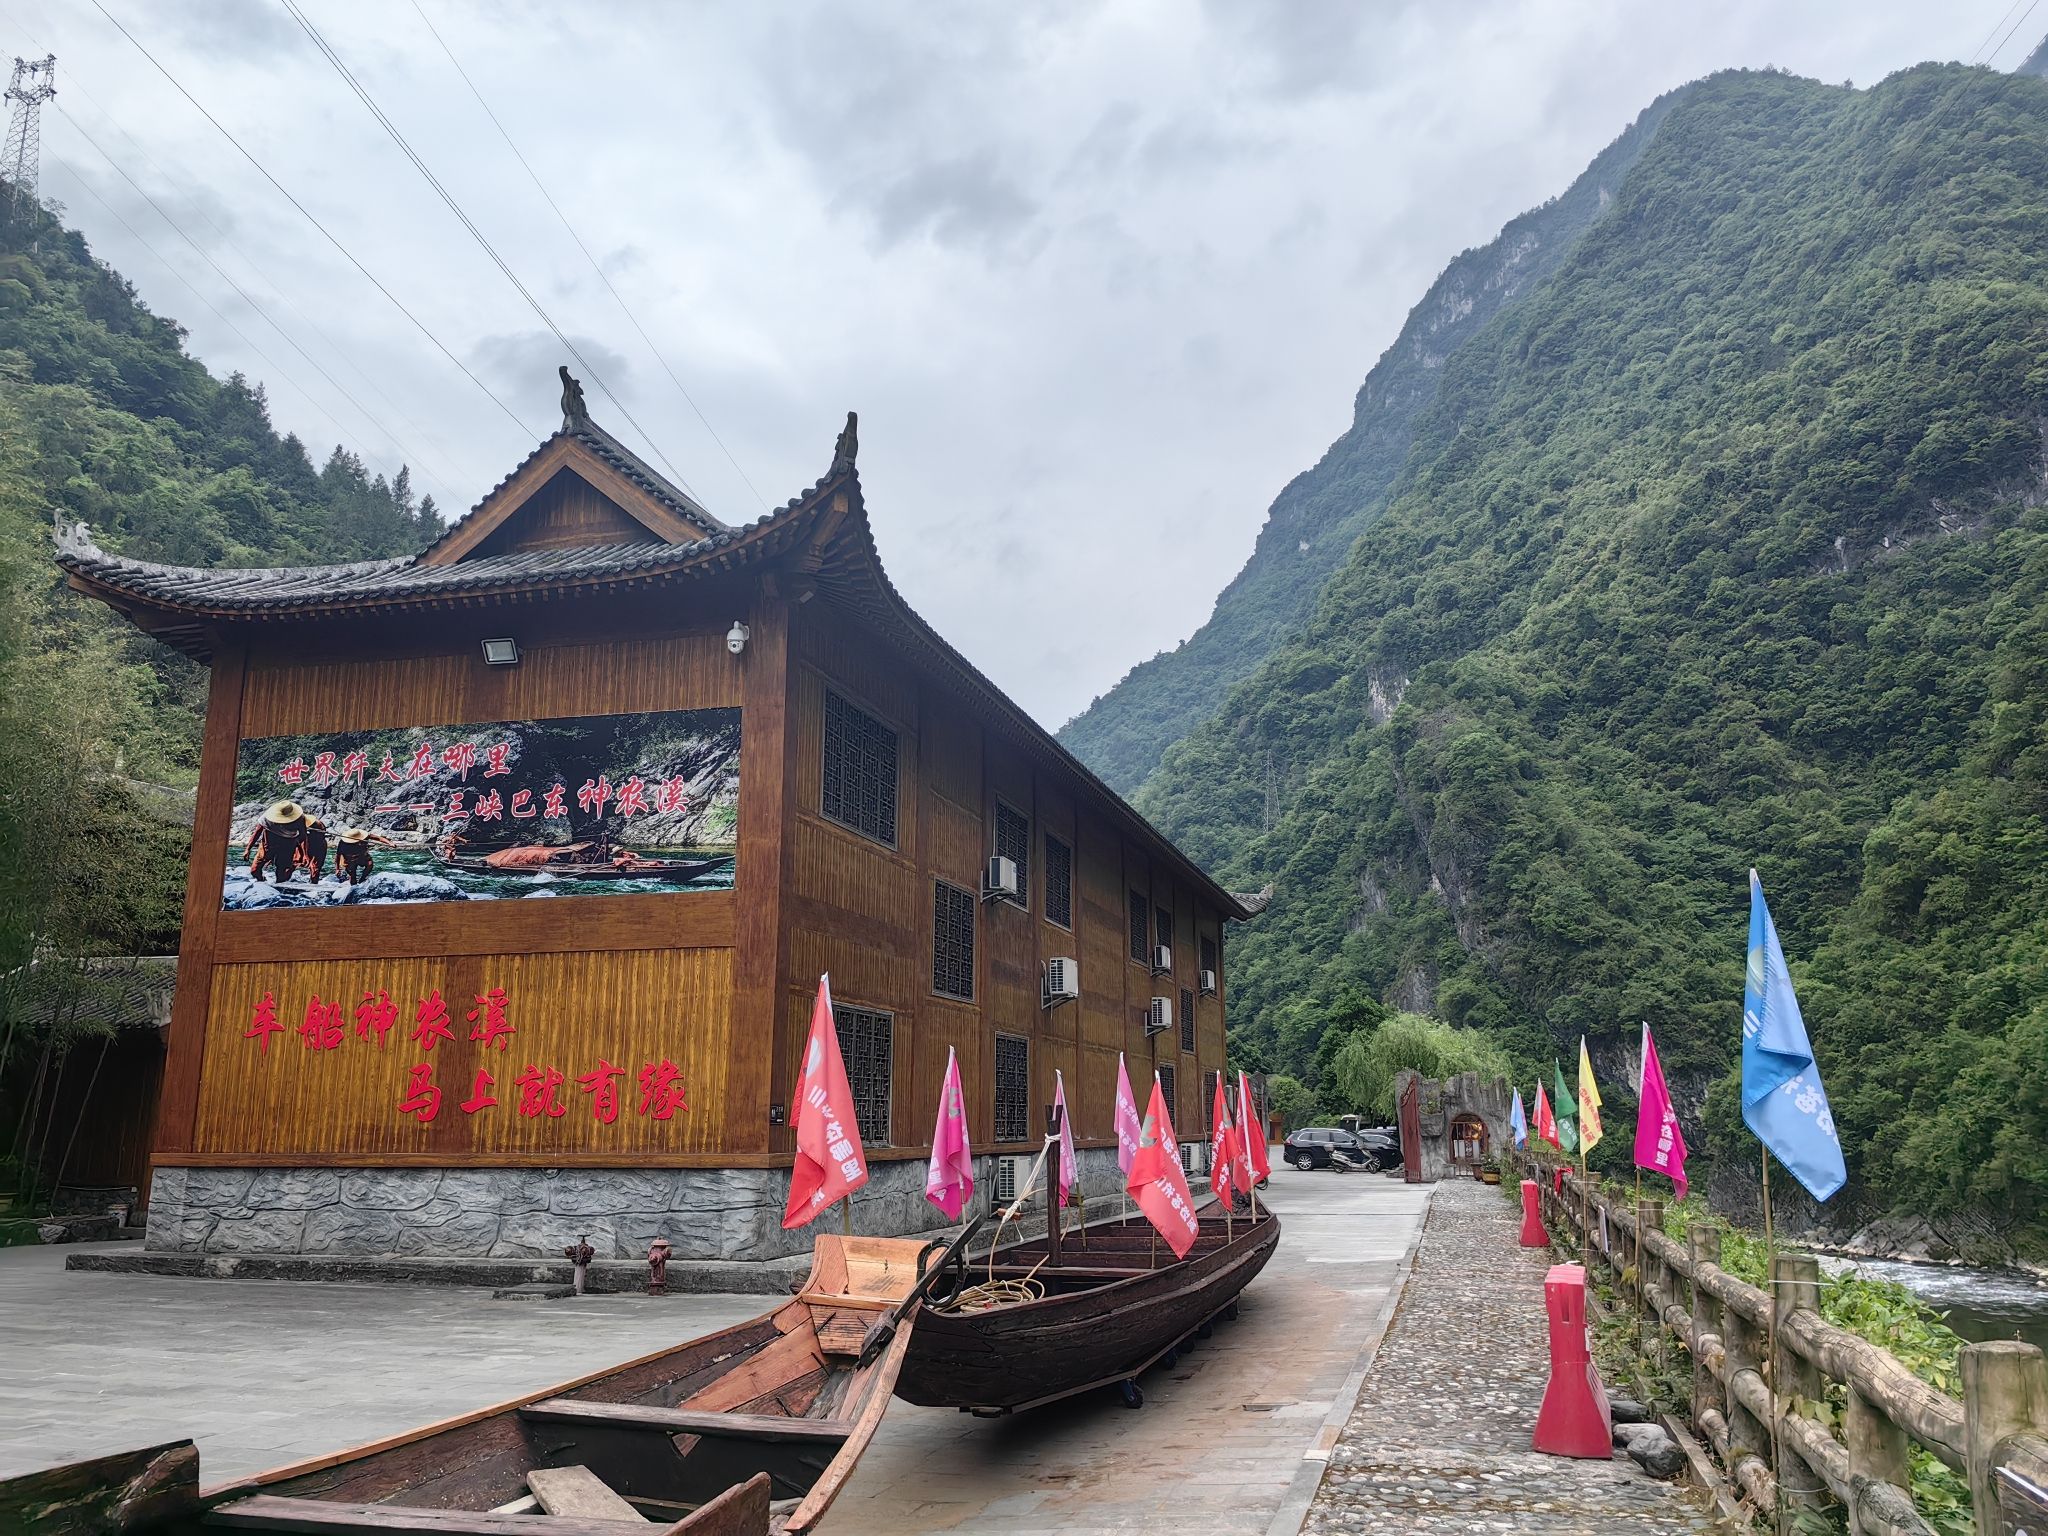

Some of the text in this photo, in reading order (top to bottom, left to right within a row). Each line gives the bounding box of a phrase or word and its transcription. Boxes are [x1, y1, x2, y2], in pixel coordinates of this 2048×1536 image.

[278, 740, 512, 788] 世界纤夫在哪里
[243, 987, 516, 1057] 车船神农溪
[398, 1059, 689, 1123] 马上就有缘
